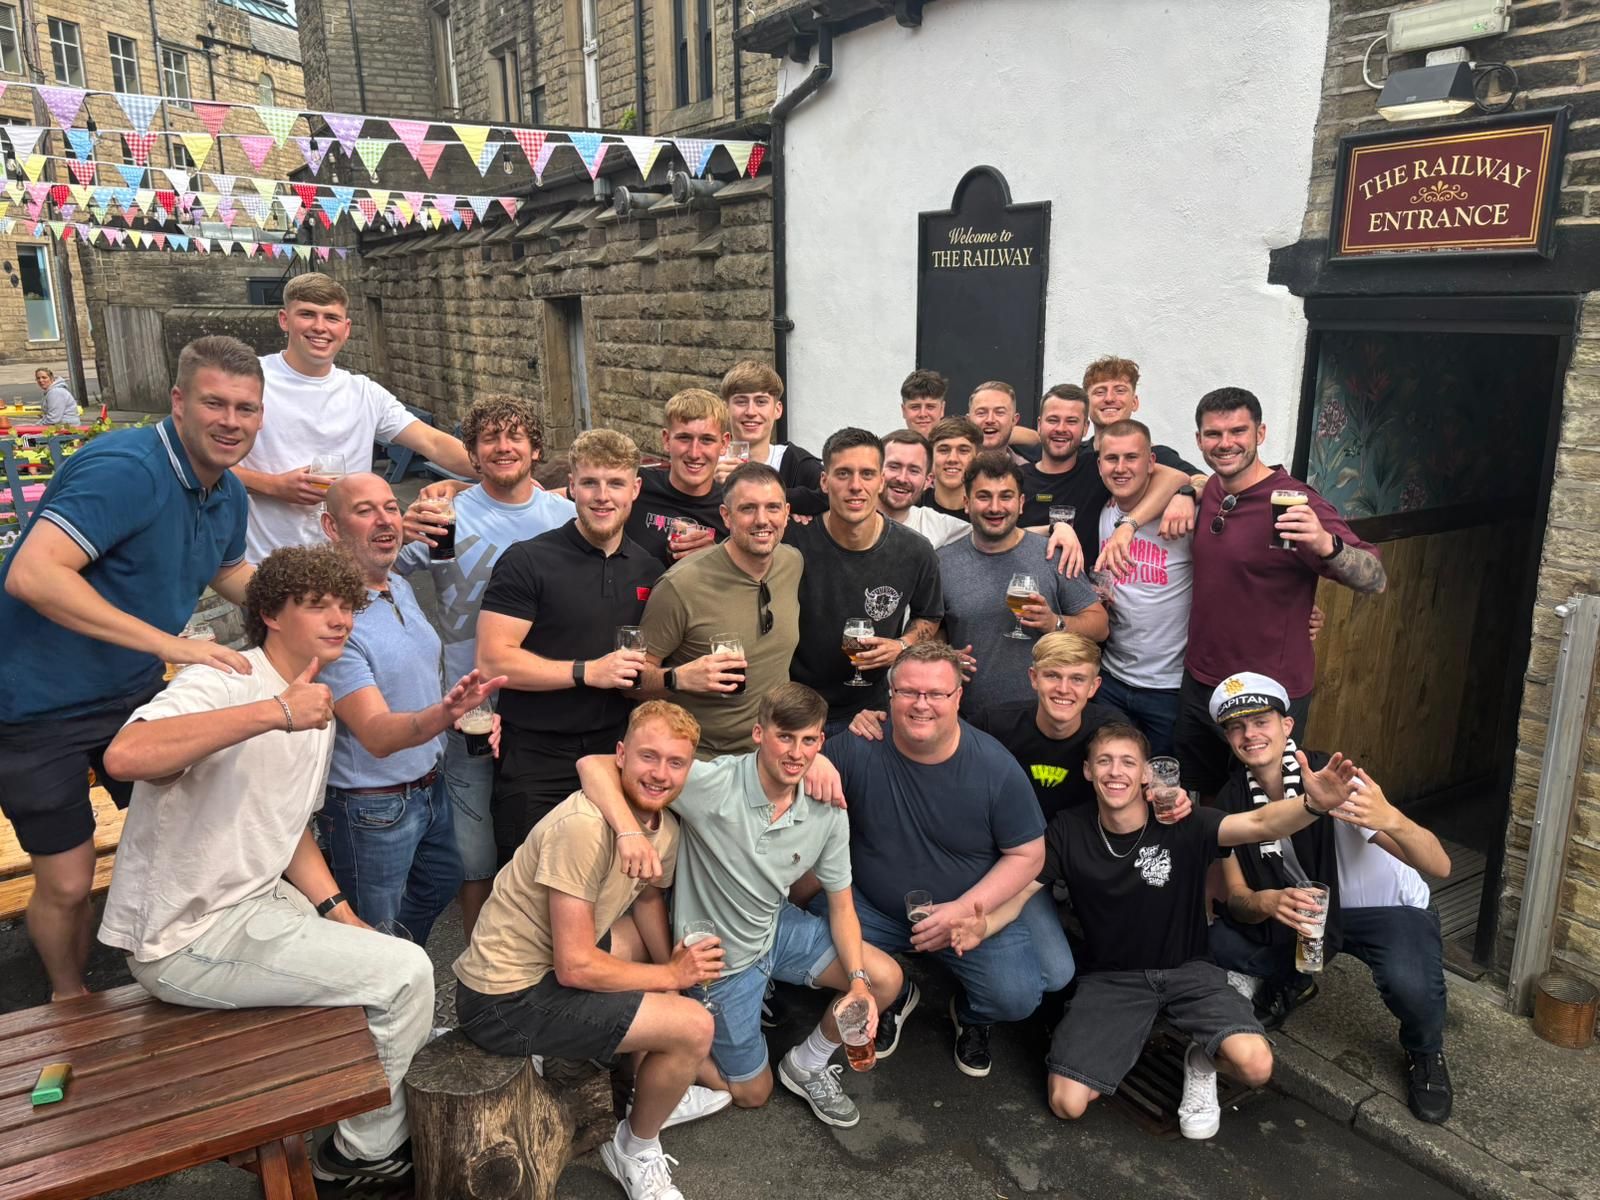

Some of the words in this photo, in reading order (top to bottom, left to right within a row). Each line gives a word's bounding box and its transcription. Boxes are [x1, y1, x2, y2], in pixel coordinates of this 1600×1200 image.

[1359, 165, 1408, 201] THE
[1413, 155, 1532, 188] RAILWAY
[1368, 203, 1510, 233] ENTRANCE
[948, 226, 998, 245] Welcome
[1000, 229, 1014, 242] to
[932, 250, 960, 268] THE
[963, 247, 1033, 267] RAILWAY
